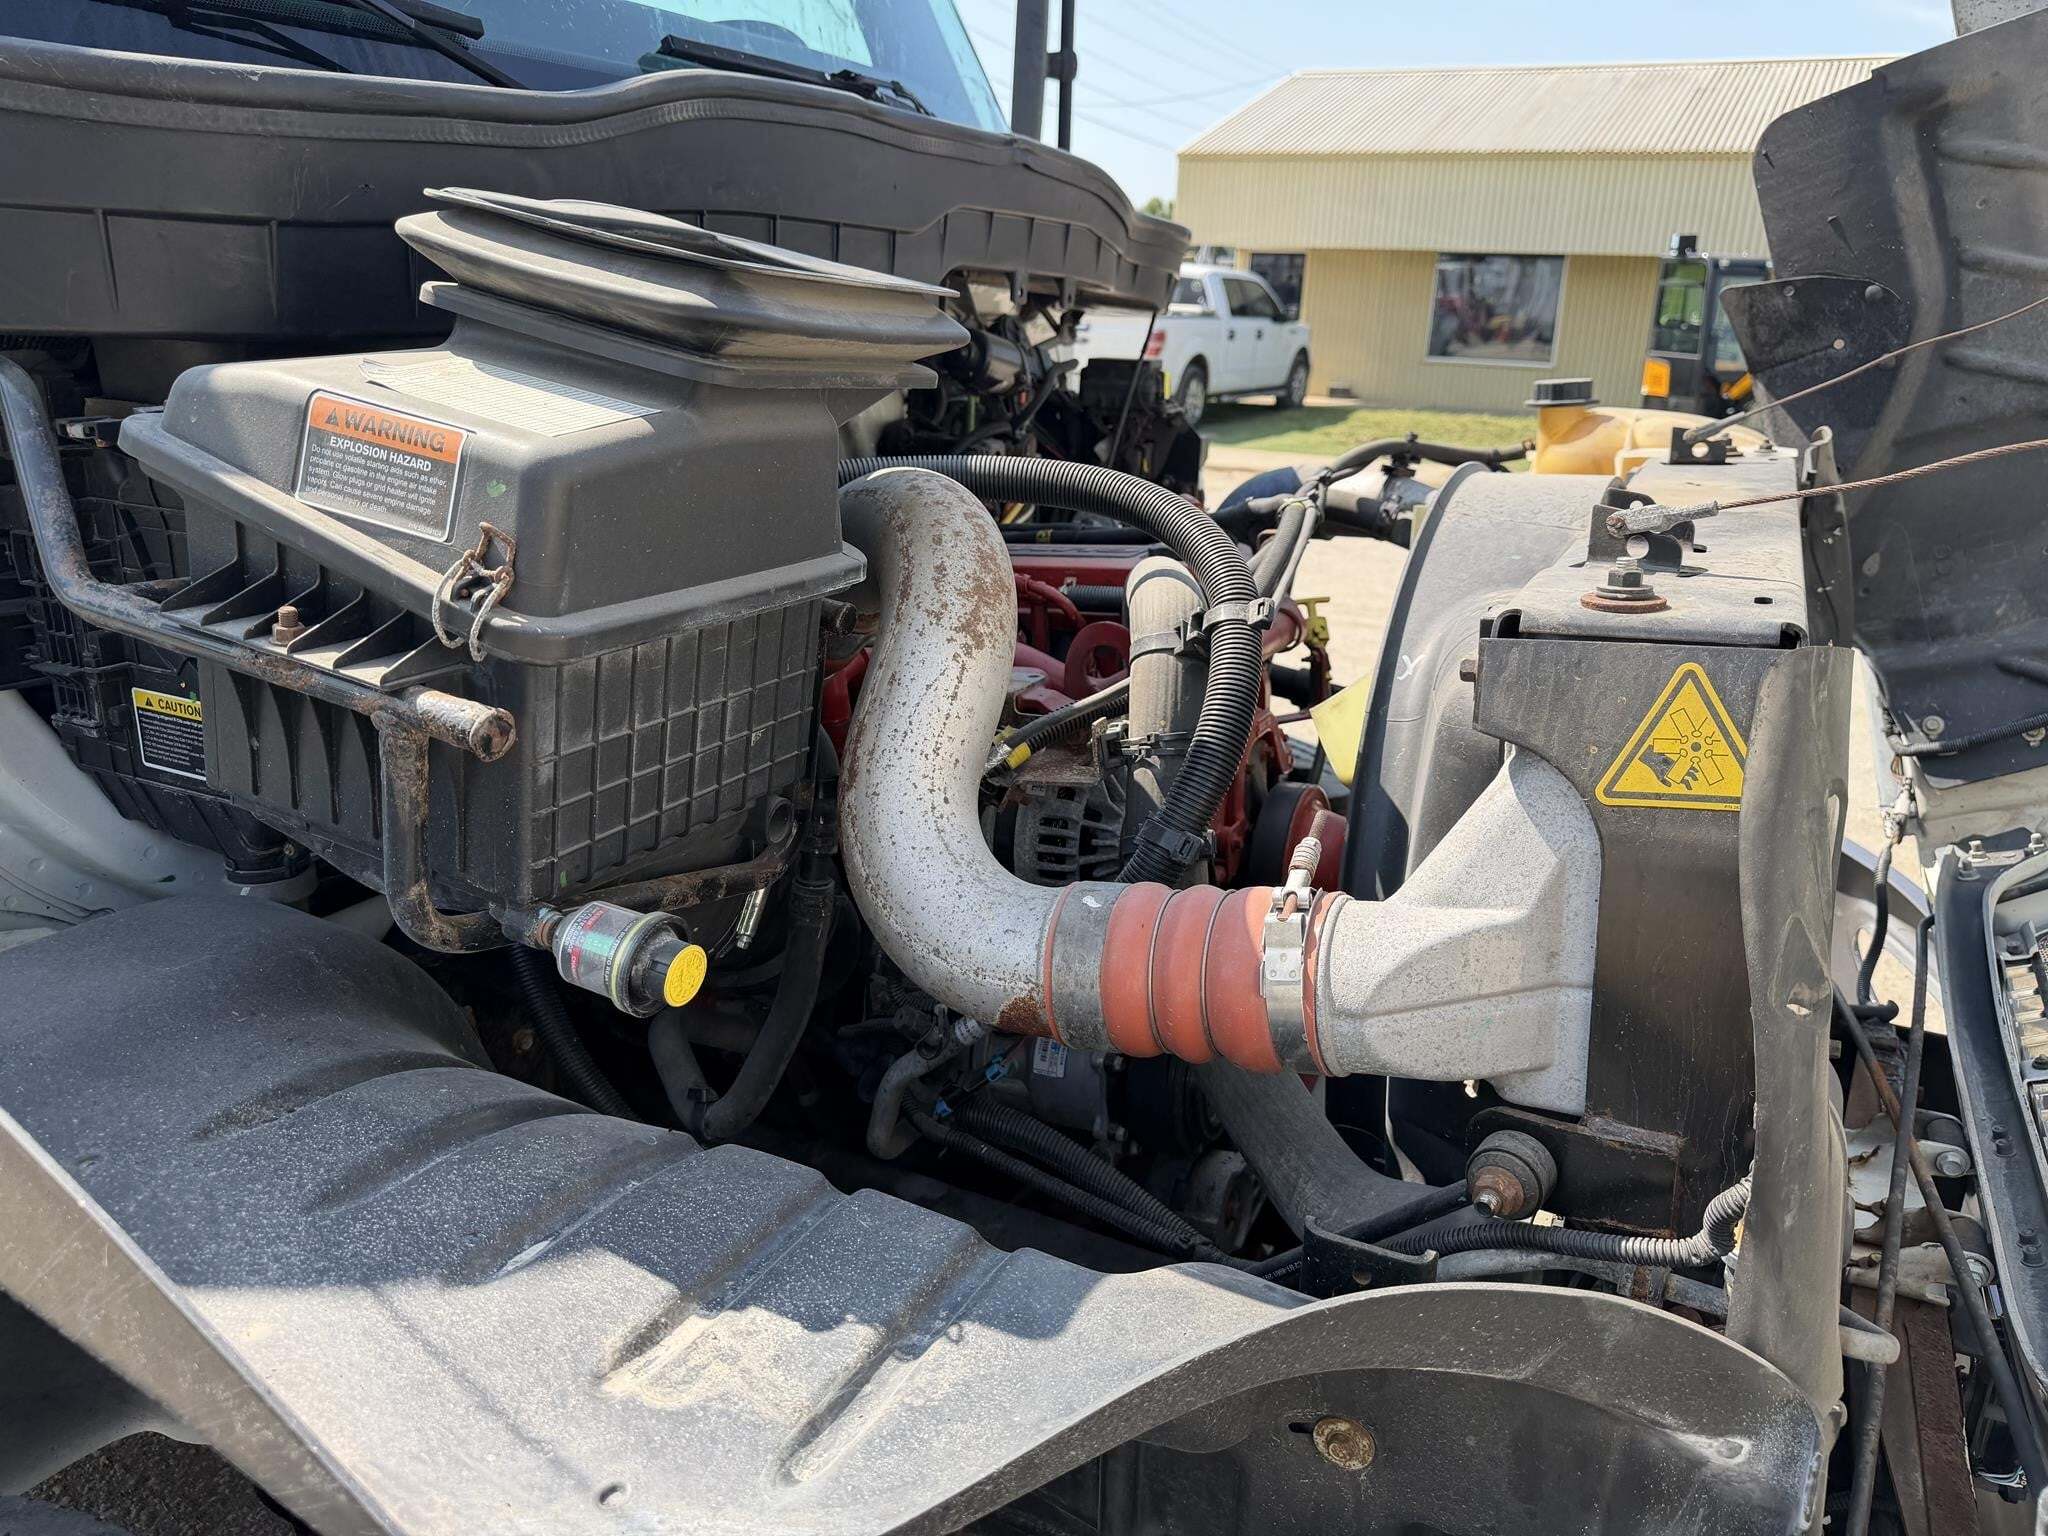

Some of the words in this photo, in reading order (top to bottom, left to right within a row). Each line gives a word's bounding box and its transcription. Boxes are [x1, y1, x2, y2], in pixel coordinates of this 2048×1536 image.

[345, 409, 445, 453] WARNING
[311, 444, 320, 452] Do
[331, 450, 343, 458] use
[343, 452, 366, 464] volatile
[365, 459, 389, 472] starting
[389, 466, 403, 475] aids
[403, 469, 419, 479] such
[329, 436, 387, 459] EXPLOSION
[389, 452, 432, 471] HAZARD
[309, 455, 334, 467] propane
[341, 464, 368, 477] gasoline
[375, 472, 385, 481] the
[386, 476, 408, 488] engine
[408, 482, 417, 490] air
[417, 484, 437, 495] intake
[331, 471, 348, 481] Glow
[348, 476, 365, 487] plugs
[373, 483, 386, 493] grid
[386, 486, 406, 497] heater
[406, 491, 418, 500] will
[418, 495, 436, 505] ignite
[316, 489, 343, 501] personal
[329, 480, 343, 490] Can
[342, 485, 361, 495] cause
[362, 491, 383, 501] severe
[383, 497, 405, 508] engine
[158, 698, 201, 717] CAUTION
